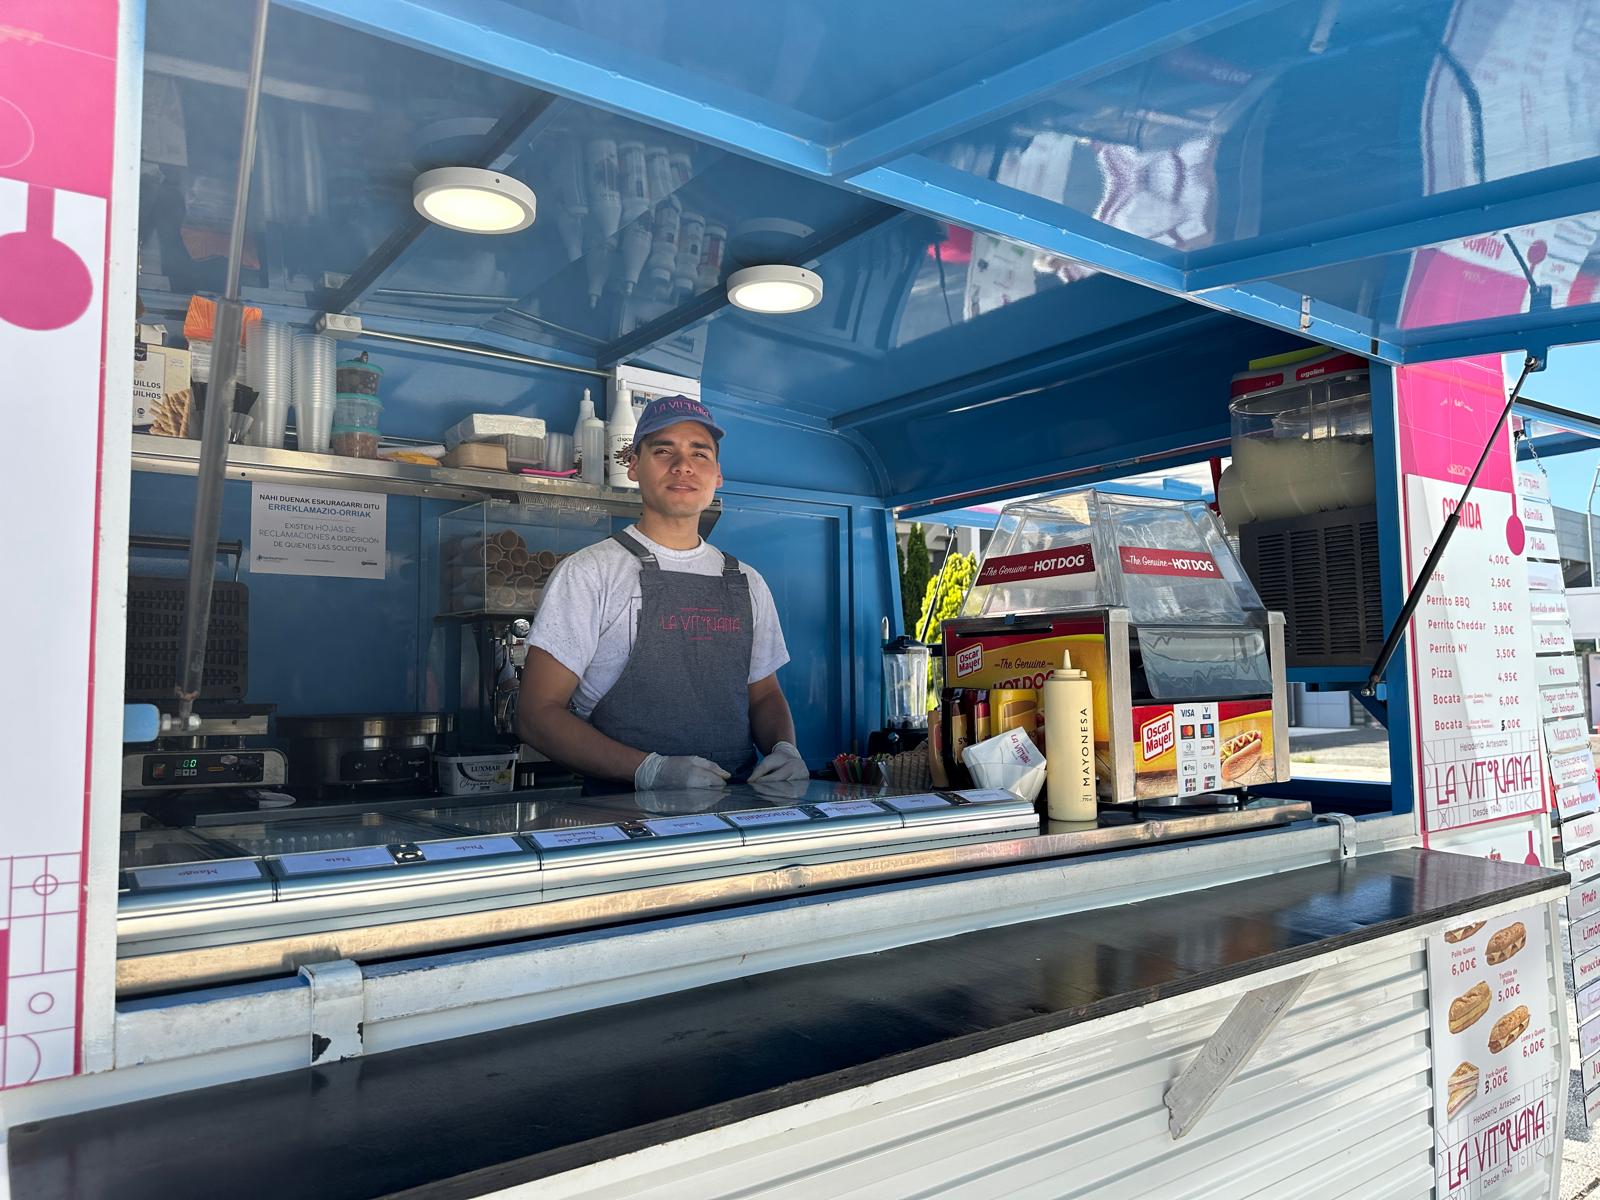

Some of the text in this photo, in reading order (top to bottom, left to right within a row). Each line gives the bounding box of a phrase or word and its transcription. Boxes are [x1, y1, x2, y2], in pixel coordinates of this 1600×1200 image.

[1300, 368, 1324, 378] ugolini
[280, 496, 310, 504] DUENAK
[312, 498, 362, 508] ESKURAGARRI
[268, 504, 372, 518] ERREKLAMAZIO-ORRIAK
[284, 522, 314, 530] EXISTEN
[259, 529, 330, 540] RECLAMACIONES
[986, 555, 1085, 577] The Genuine HOT DOG
[1130, 555, 1214, 572] The Genuine HOT DOG
[1426, 595, 1452, 606] Perrito
[1455, 597, 1470, 608] BBQ
[1428, 620, 1454, 630] Perrito
[1456, 620, 1486, 630] Cheddar
[1540, 634, 1565, 646] Avellana
[1430, 644, 1456, 653] Perrito
[1458, 644, 1468, 653] NY
[960, 650, 978, 664] Oscar
[959, 658, 981, 672] Mayer
[1000, 658, 1046, 669] The Genuine
[1432, 668, 1452, 678] Pizza
[1433, 693, 1461, 704] Bocata
[1543, 691, 1556, 703] Yogur
[1181, 709, 1194, 717] VISA
[1560, 704, 1575, 714] bosque
[1146, 720, 1170, 739] Oscar
[1434, 720, 1462, 730] Bocata
[1080, 708, 1090, 786] MAYONESA
[1146, 732, 1172, 754] Mayer
[1436, 765, 1456, 805] LA
[1472, 804, 1488, 816] Desde
[1580, 859, 1594, 872] Oreo
[1463, 946, 1476, 955] Queso
[1452, 958, 1476, 976] 6,00€
[1498, 984, 1520, 1002] 5,00€
[1534, 1028, 1546, 1036] Queso
[1523, 1038, 1544, 1058] 6,00€
[1499, 1094, 1520, 1110] Artesana
[1448, 1142, 1468, 1190] LA
[1484, 1173, 1500, 1188] Desde
